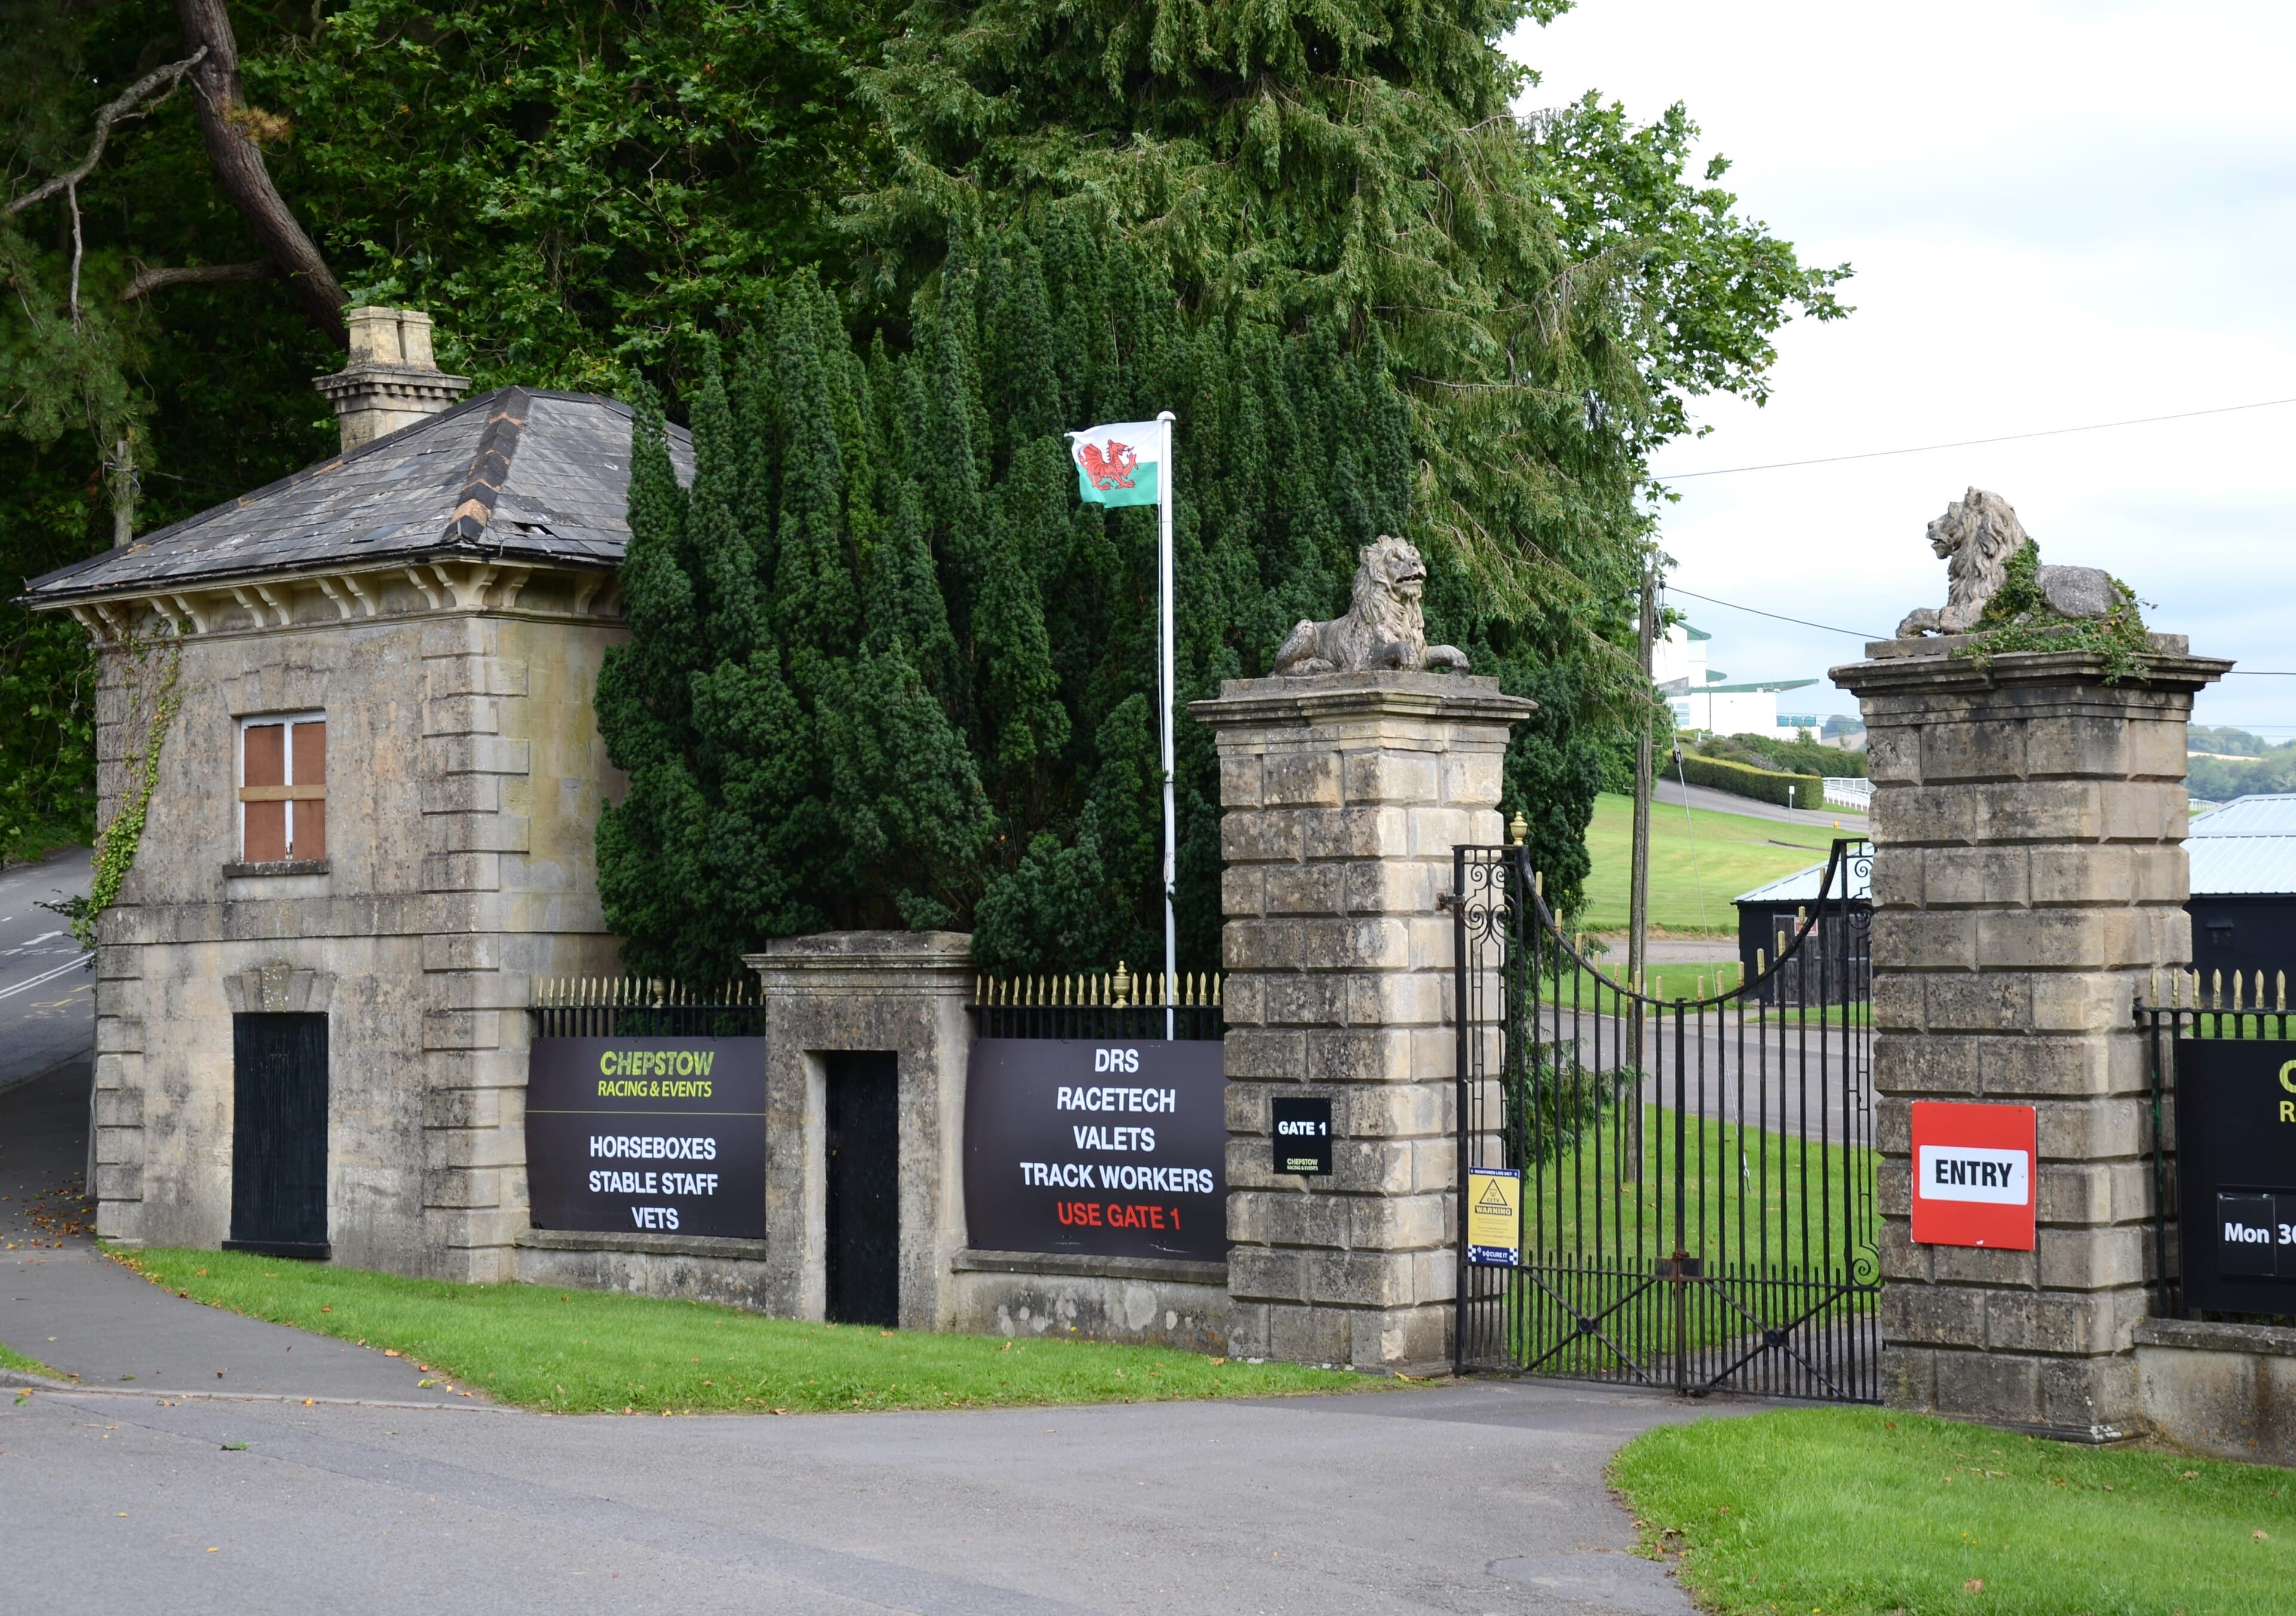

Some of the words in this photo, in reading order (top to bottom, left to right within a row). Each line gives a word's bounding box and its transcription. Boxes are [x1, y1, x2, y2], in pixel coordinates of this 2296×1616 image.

[600, 1050, 715, 1076] CHEPSTOW
[1094, 1049, 1139, 1073] DRS
[597, 1080, 648, 1098] RACING
[649, 1080, 660, 1098] &
[661, 1080, 713, 1098] EVENTS
[1057, 1086, 1176, 1113] RACETECH
[1073, 1125, 1155, 1152] VALETS
[1278, 1121, 1315, 1135] GATE
[1319, 1122, 1326, 1136] 1
[590, 1135, 716, 1160] HORSEBOXES
[589, 1170, 658, 1194] STABLE
[661, 1172, 718, 1196] STAFF
[1019, 1162, 1095, 1189] TRACK
[1098, 1165, 1214, 1193] WORKERS
[1935, 1159, 2013, 1188] ENTRY
[631, 1206, 679, 1230] VETS
[1057, 1201, 1103, 1227] USE
[1107, 1203, 1165, 1230] GATE
[1170, 1208, 1181, 1230] 1
[1476, 1206, 1511, 1215] WARNING
[2225, 1223, 2270, 1244] Mon
